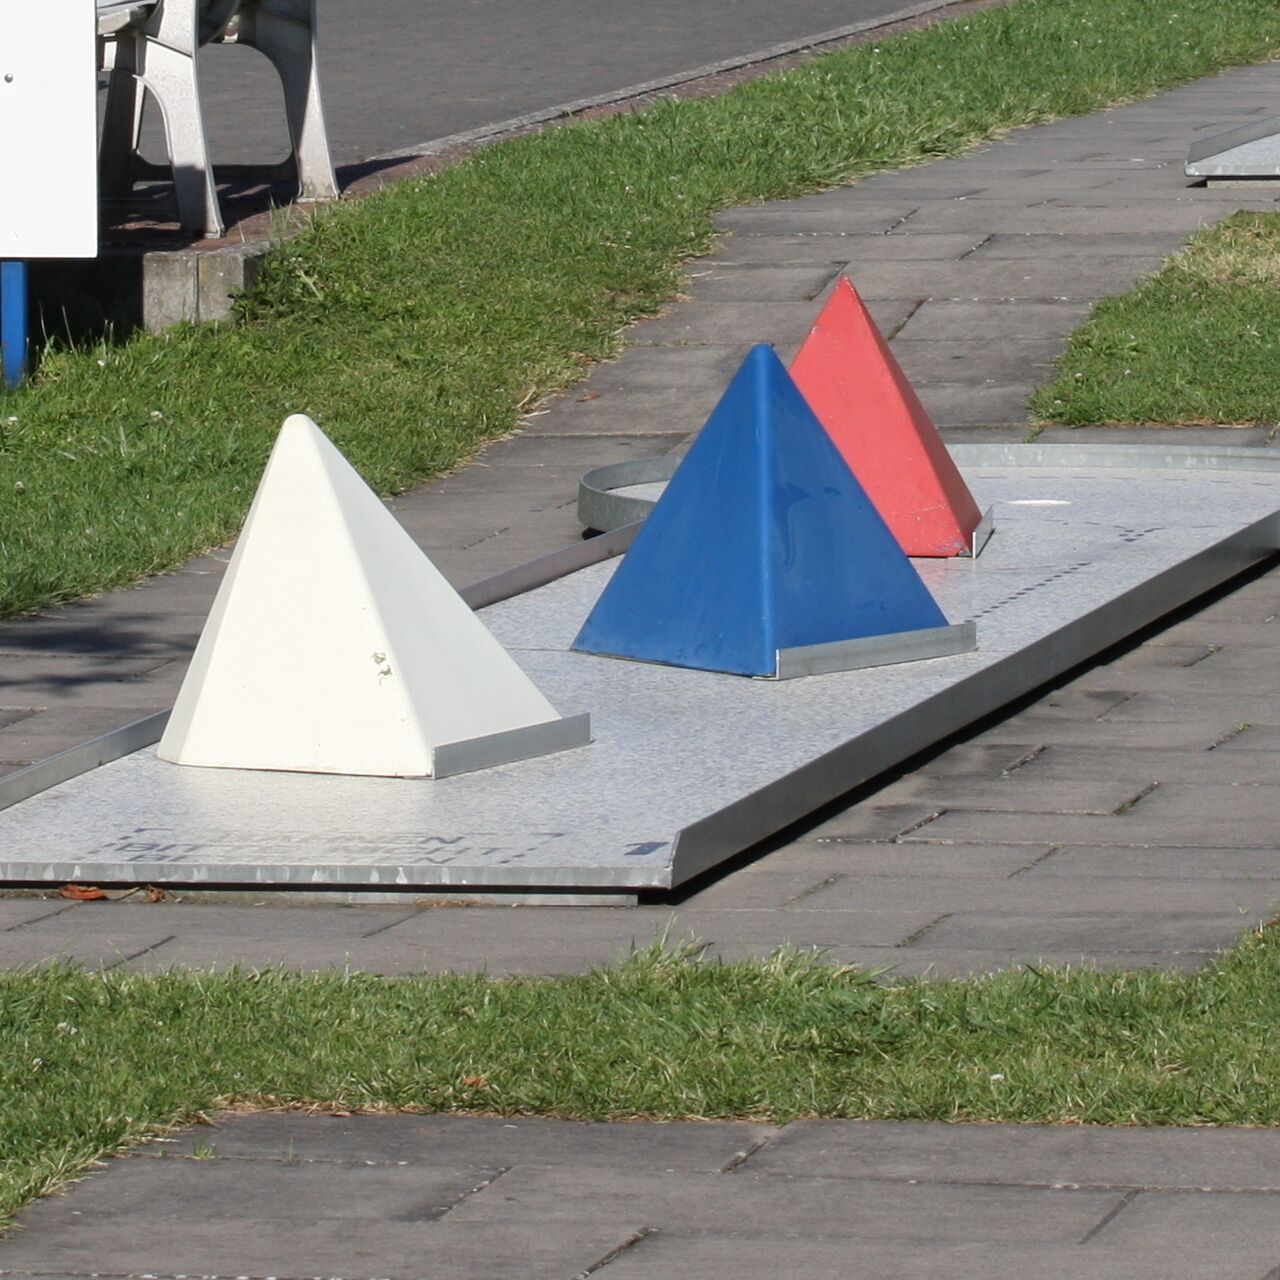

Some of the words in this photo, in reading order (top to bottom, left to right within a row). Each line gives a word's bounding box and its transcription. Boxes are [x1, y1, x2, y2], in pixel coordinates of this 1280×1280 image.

[114, 842, 300, 854] BITTE
[324, 845, 512, 856] NICHT
[622, 841, 670, 856] 1
